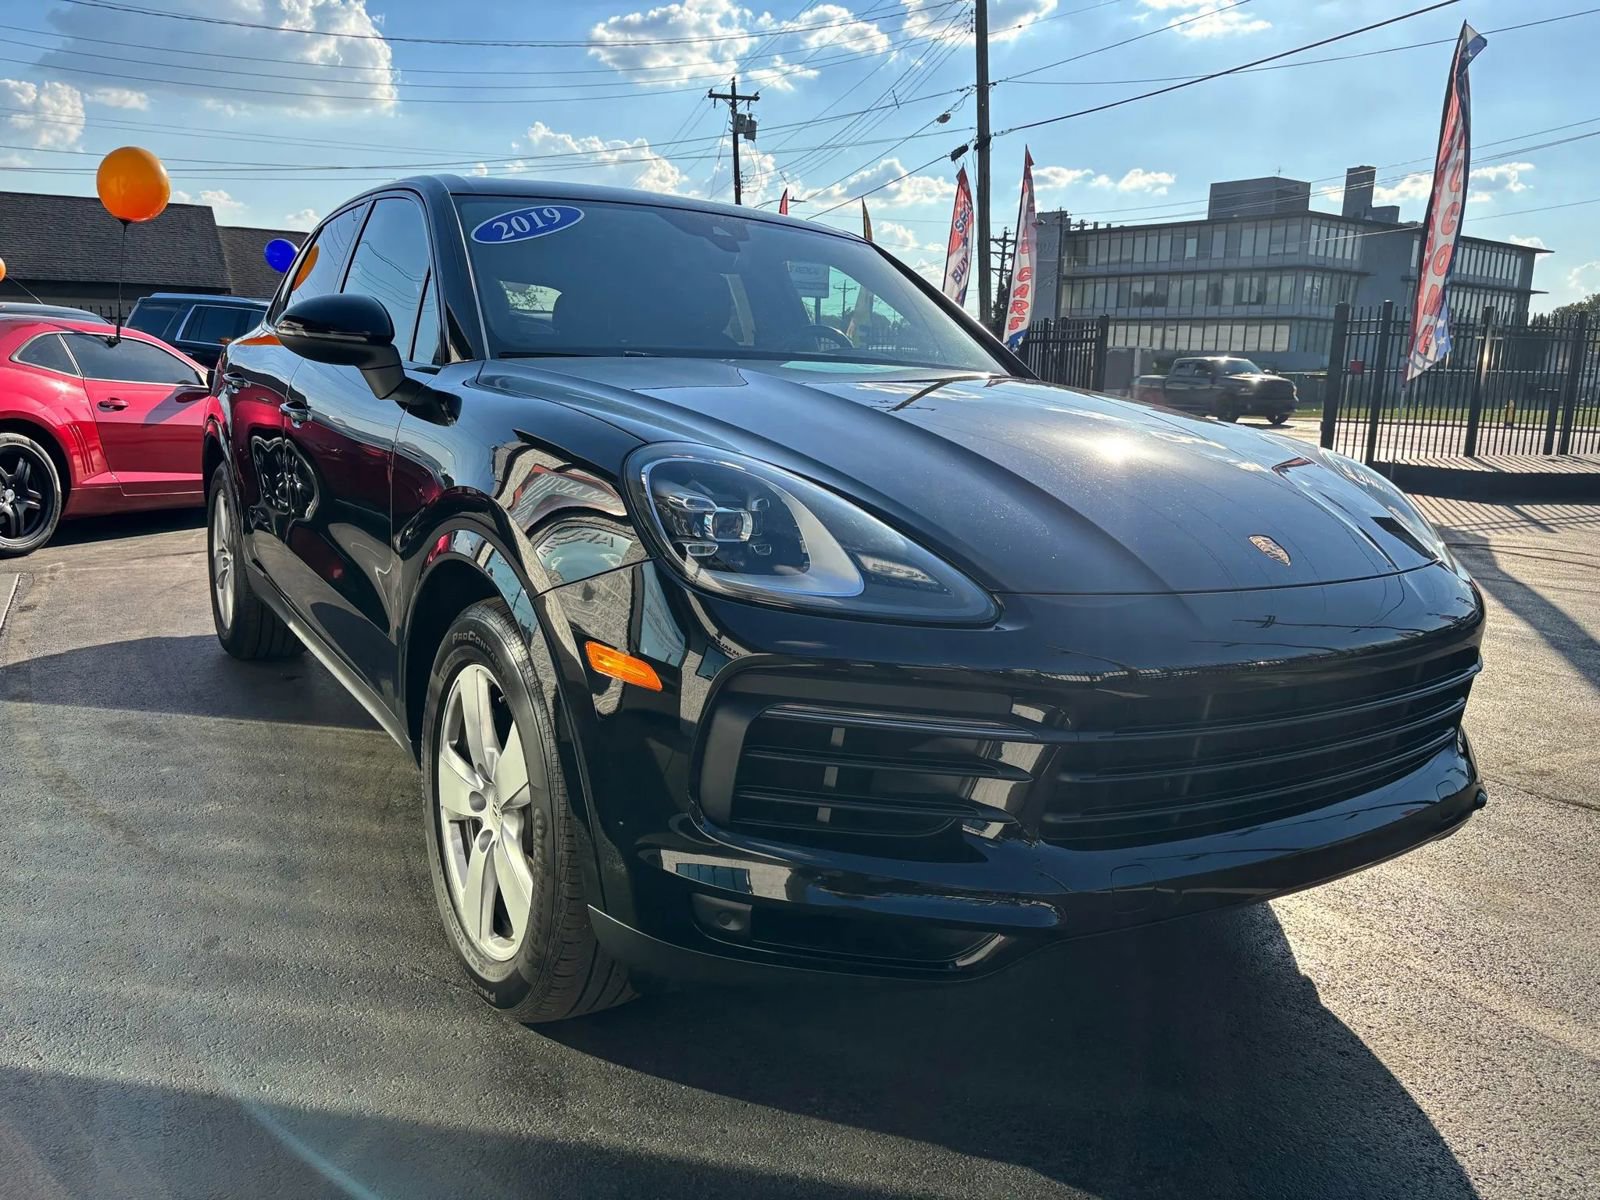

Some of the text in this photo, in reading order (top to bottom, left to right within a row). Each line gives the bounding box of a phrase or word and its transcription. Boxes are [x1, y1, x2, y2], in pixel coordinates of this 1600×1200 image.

[491, 207, 561, 240] 2019
[1416, 127, 1465, 357] LCOME
[1008, 266, 1034, 330] CARS
